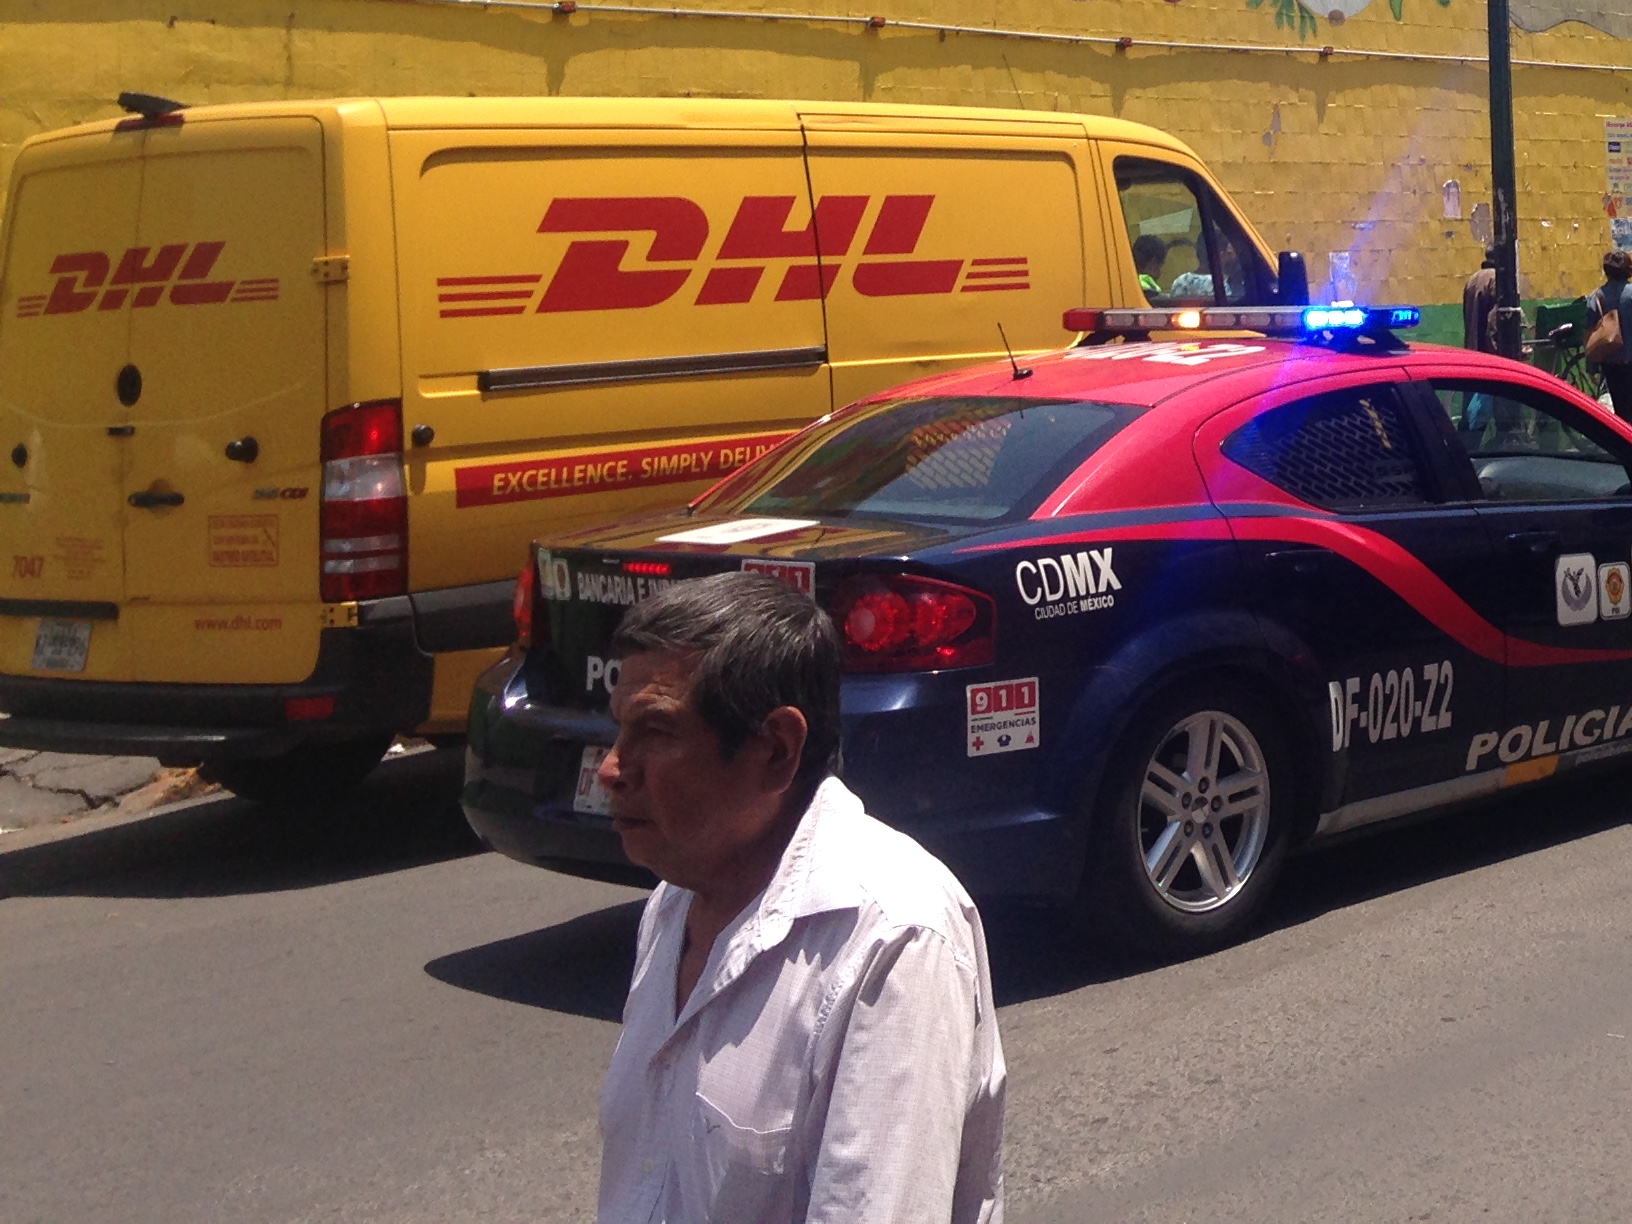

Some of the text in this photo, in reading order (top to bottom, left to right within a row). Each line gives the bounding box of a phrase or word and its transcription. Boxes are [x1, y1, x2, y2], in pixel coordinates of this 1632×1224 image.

[534, 194, 964, 313] DHL
[43, 241, 236, 314] DHL
[492, 460, 632, 496] EXCELLENCE.
[640, 450, 714, 477] SIMPLY
[577, 572, 635, 605] BANCARIA
[1015, 547, 1122, 605] CDMX
[195, 618, 282, 630] www.dhl.com
[1035, 594, 1115, 620] CIUDAD DE MÉXICO
[975, 685, 1030, 712] 911
[1329, 660, 1453, 752] DF-020-Z2
[970, 716, 1037, 733] EMERGENCIAS
